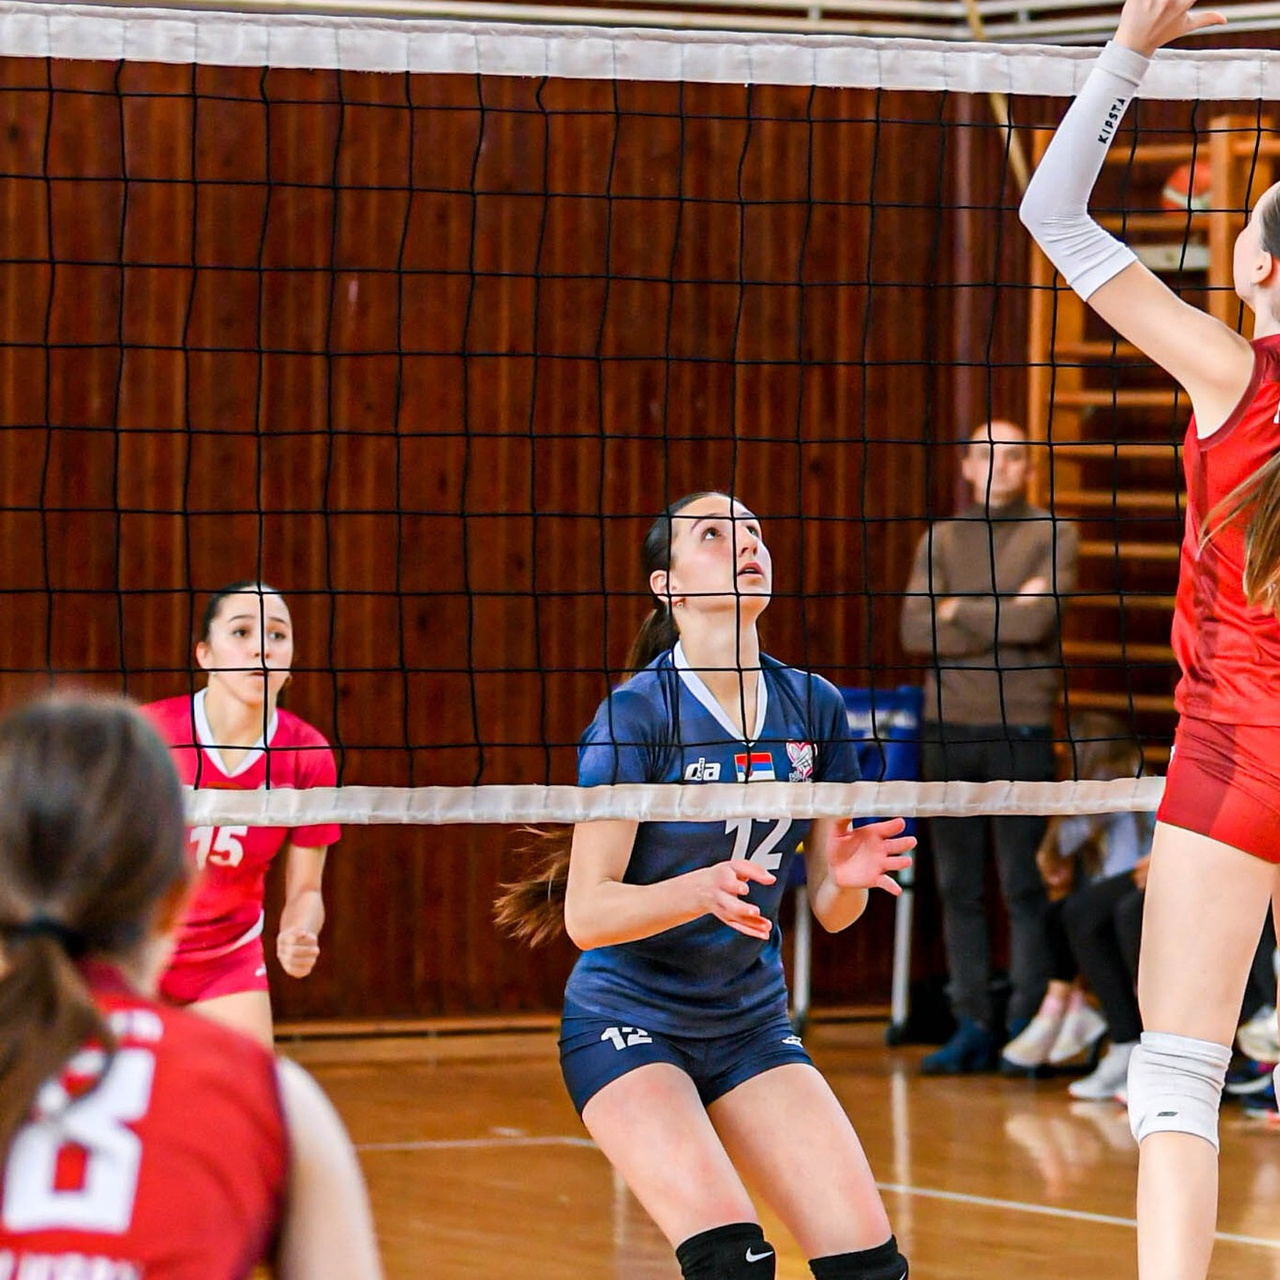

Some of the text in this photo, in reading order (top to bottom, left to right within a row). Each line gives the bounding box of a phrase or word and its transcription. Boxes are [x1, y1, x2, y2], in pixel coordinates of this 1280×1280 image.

[1097, 98, 1126, 144] KIPSTA
[190, 825, 248, 870] 15
[725, 817, 793, 870] 12
[601, 1027, 653, 1051] 12
